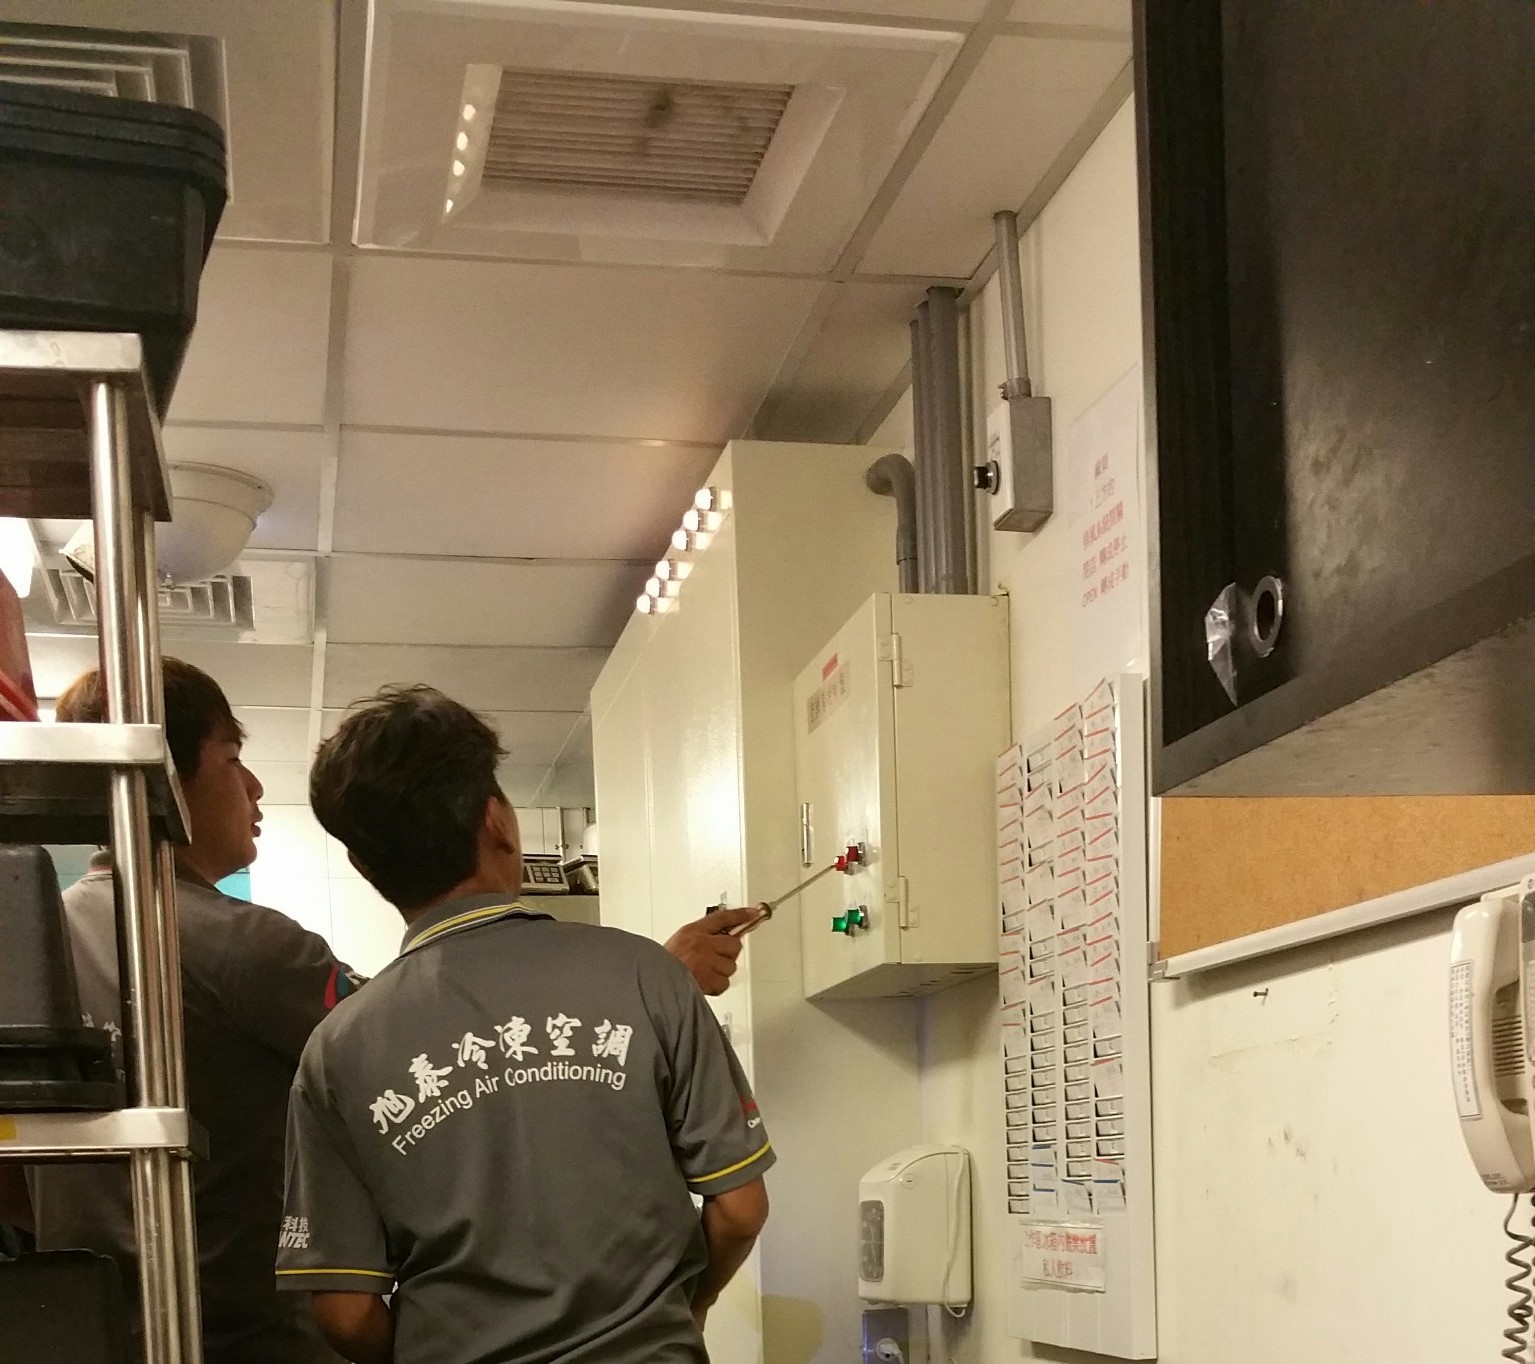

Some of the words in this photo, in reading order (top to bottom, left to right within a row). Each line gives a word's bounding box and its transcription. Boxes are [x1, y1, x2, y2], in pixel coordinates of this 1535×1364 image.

[391, 1088, 474, 1157] Freezing
[474, 1074, 500, 1100] Air
[504, 1061, 627, 1092] Conditioning
